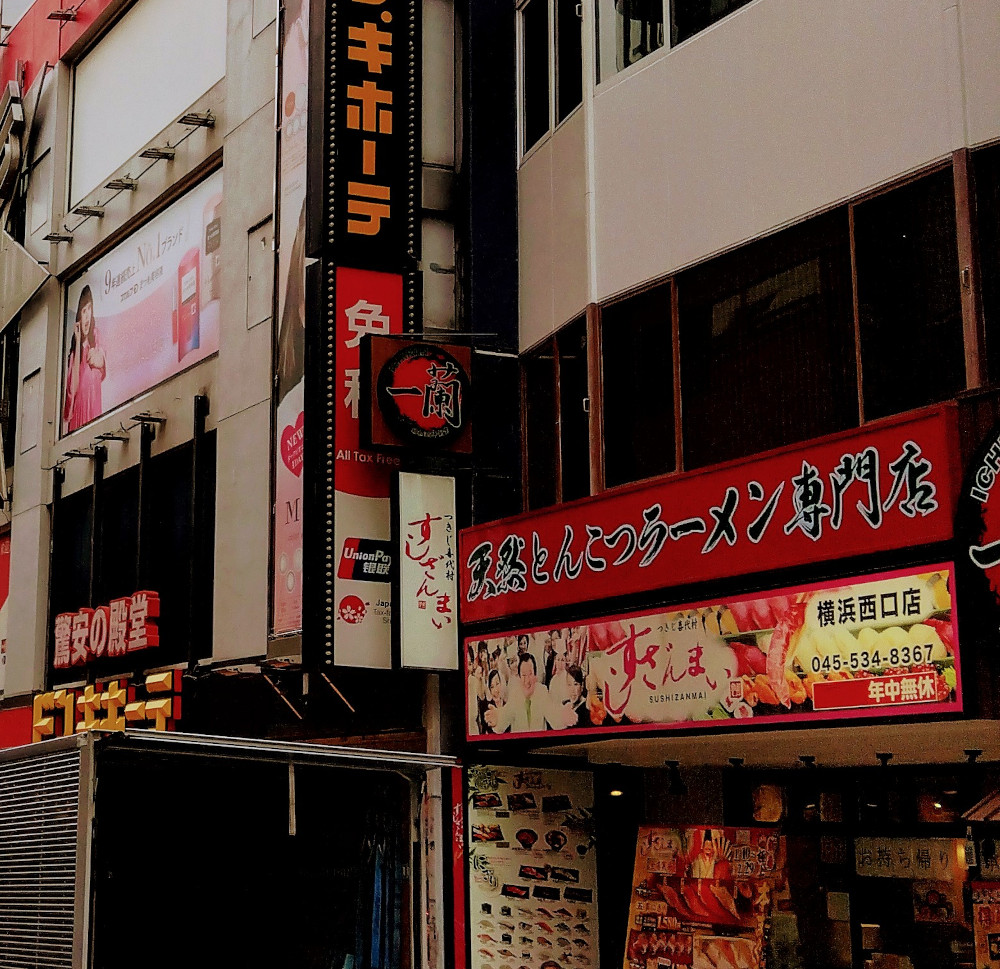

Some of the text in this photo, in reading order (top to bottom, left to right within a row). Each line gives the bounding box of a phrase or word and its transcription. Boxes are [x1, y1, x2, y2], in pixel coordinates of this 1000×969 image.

[386, 361, 462, 428] 一蘭
[336, 449, 401, 466] All Tax Free
[467, 440, 940, 604] 天然とんこつラーメン専門店
[405, 512, 453, 630] すしざんまい
[53, 592, 159, 669] 驚安の殿堂
[816, 587, 922, 628] 横浜西口店
[603, 623, 732, 716] すしざんまい
[811, 643, 934, 673] 045-534-8367
[649, 691, 708, 703] SUSHIZANMAI
[867, 675, 937, 703] 年中無休
